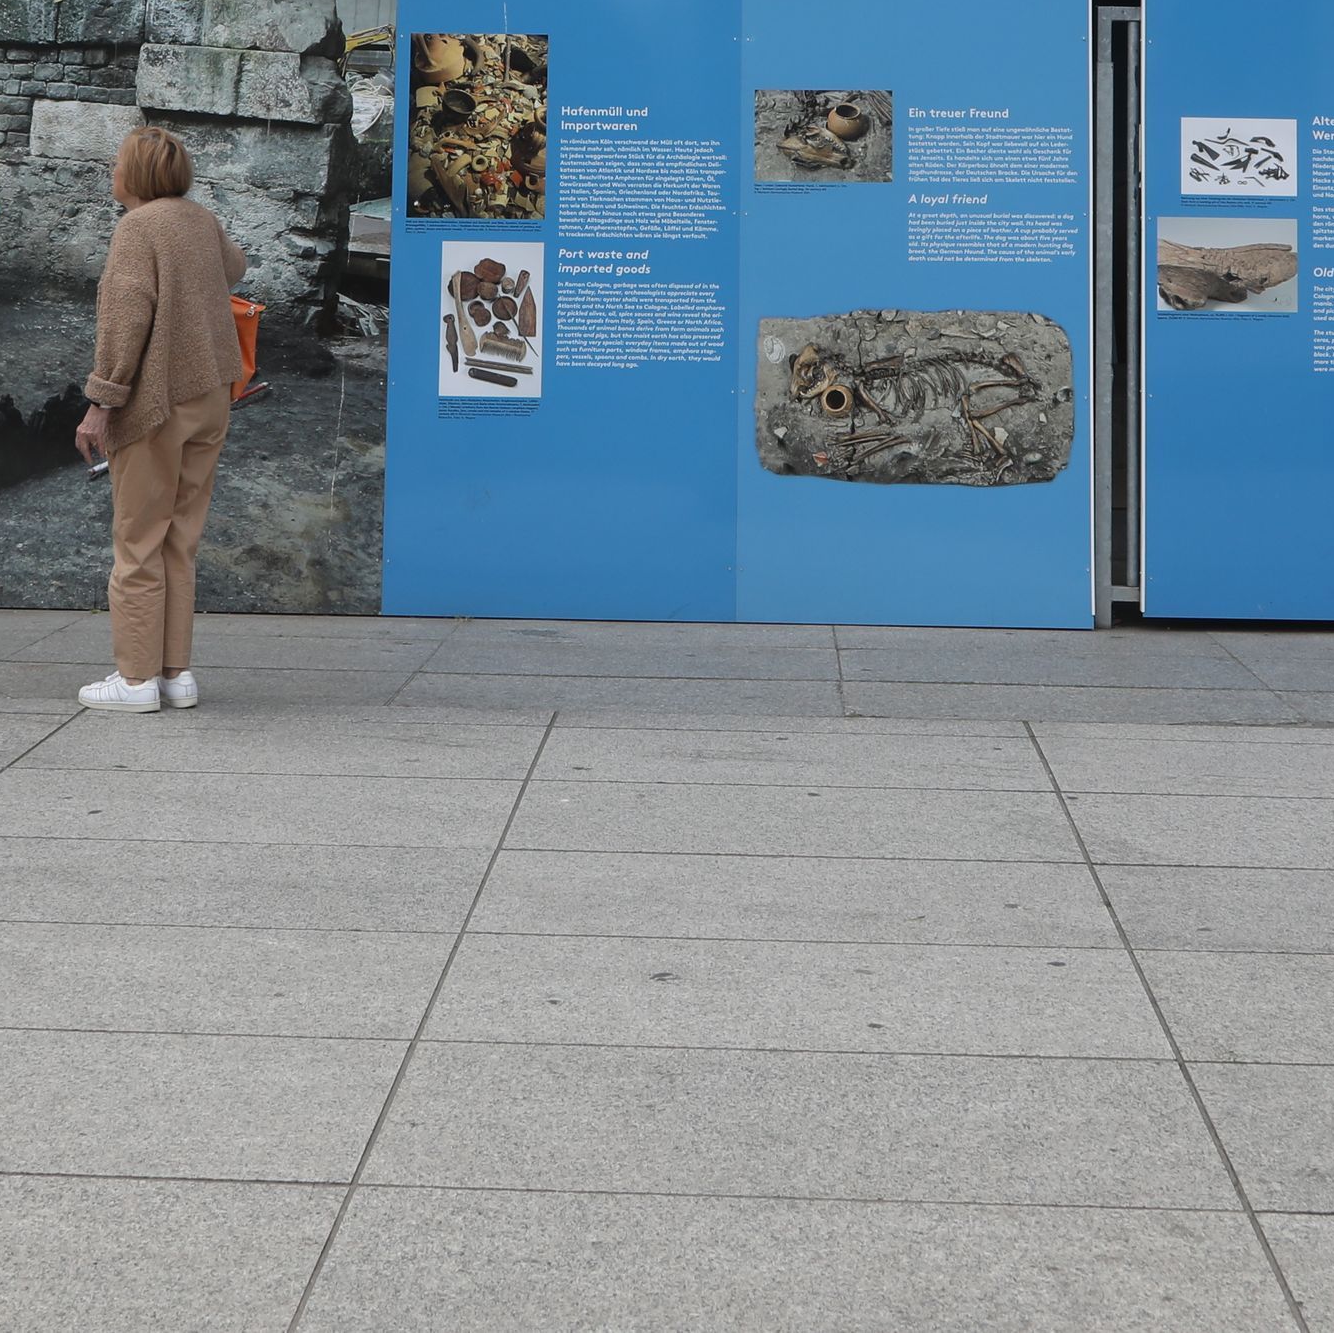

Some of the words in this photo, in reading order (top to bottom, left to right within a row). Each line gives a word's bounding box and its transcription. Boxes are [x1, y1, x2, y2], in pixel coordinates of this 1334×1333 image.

[562, 106, 622, 116] Hafenmüll
[626, 107, 648, 116] und
[909, 108, 926, 118] Ein
[929, 109, 966, 118] treuer
[970, 108, 1009, 118] Freund
[561, 120, 638, 133] Importwaren
[908, 194, 917, 203] A
[921, 194, 949, 206] loyal
[952, 194, 988, 204] friend
[559, 248, 584, 258] Port
[588, 250, 623, 259] waste
[626, 250, 649, 259] and
[558, 263, 613, 276] imported
[616, 264, 651, 276] goods
[1313, 267, 1334, 277] Old
